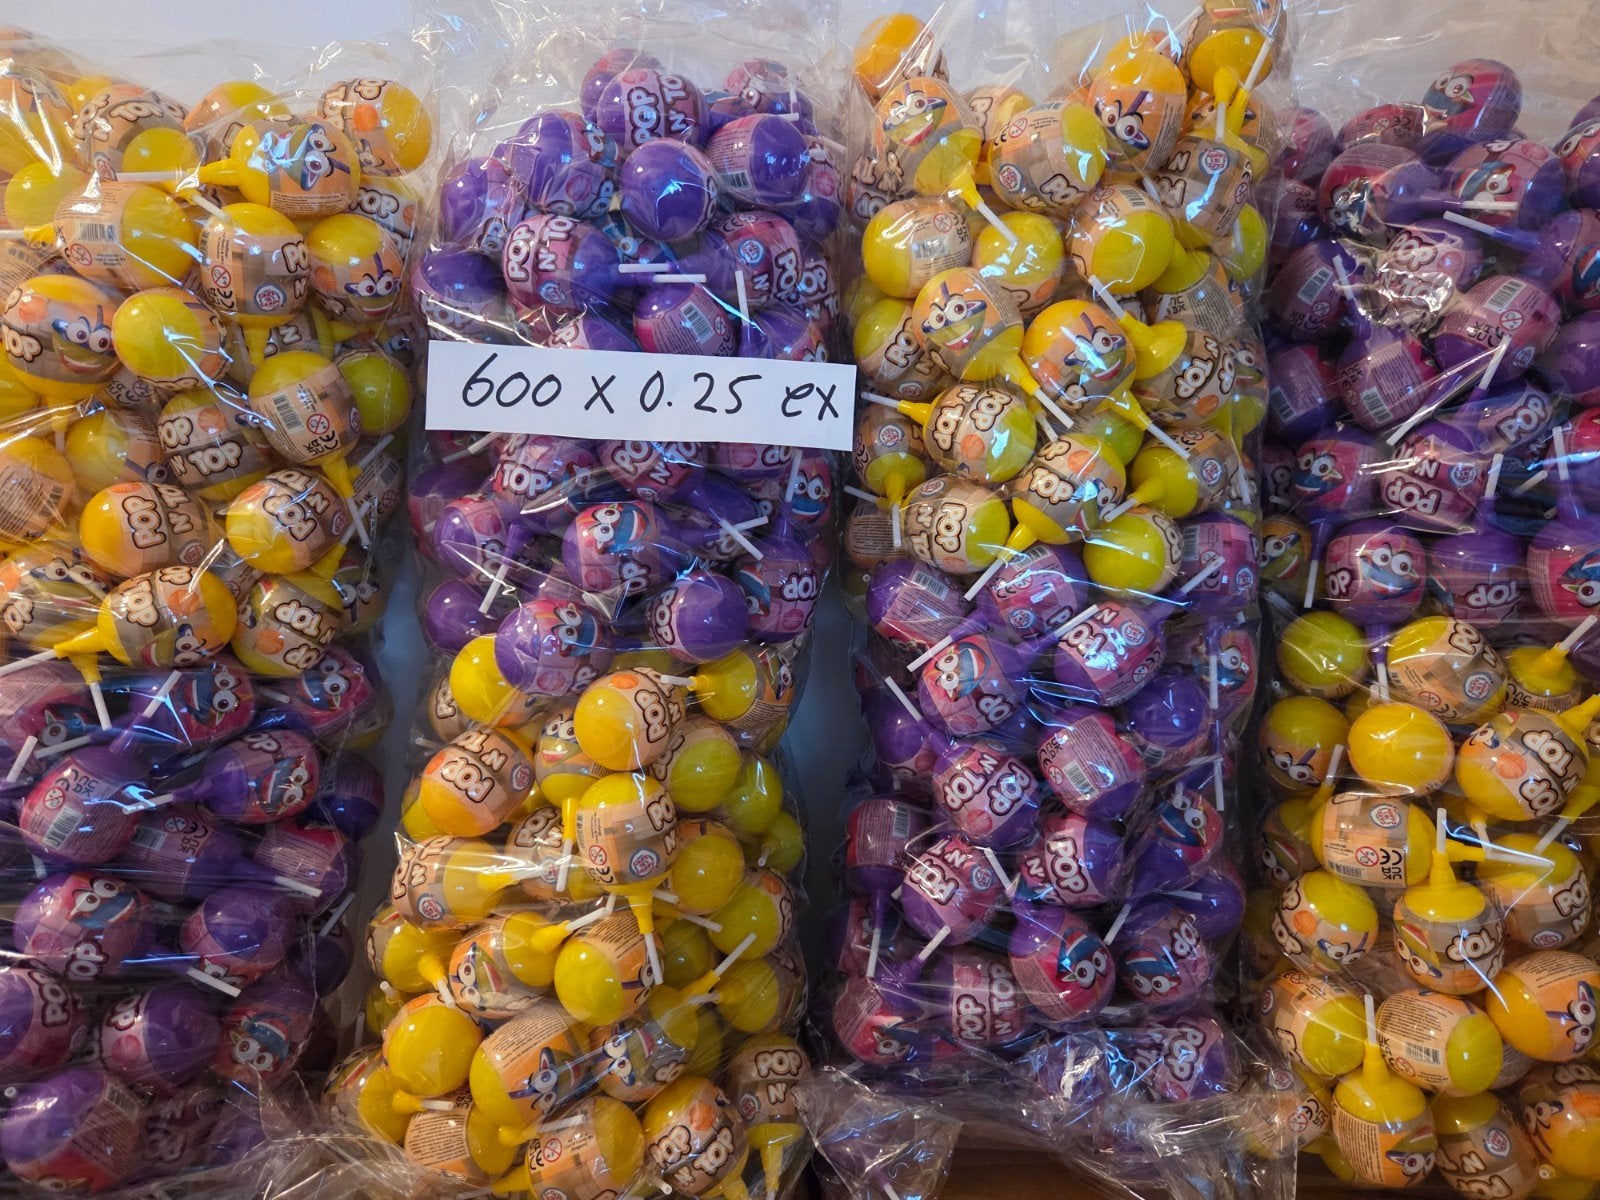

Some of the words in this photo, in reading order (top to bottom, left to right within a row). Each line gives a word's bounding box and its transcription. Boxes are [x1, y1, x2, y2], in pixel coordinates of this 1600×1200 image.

[659, 73, 689, 105] TO
[1039, 172, 1085, 206] PO
[540, 214, 578, 246] TO
[506, 224, 535, 282] POP
[798, 264, 829, 306] OP
[461, 352, 563, 408] 600
[780, 382, 840, 421] ex
[1173, 356, 1215, 400] TOP
[158, 416, 194, 448] OP
[930, 402, 965, 452] TOP
[1495, 394, 1550, 446] POP
[186, 440, 243, 476] TOP
[611, 440, 652, 477] PO
[500, 459, 553, 500] TOP
[1028, 466, 1075, 505] TOP
[1386, 476, 1443, 516] POP
[122, 494, 167, 550] POP
[262, 493, 318, 542] POP
[934, 501, 968, 553] POP
[619, 558, 652, 594] OP
[780, 571, 818, 603] TOP
[1327, 567, 1353, 600] OP
[1465, 580, 1521, 609] TOP
[274, 599, 323, 638] TOP
[655, 587, 678, 646] POP
[283, 643, 321, 670] OP
[1449, 618, 1482, 656] PO
[634, 688, 669, 744] POP
[976, 693, 1015, 725] OP
[245, 731, 282, 754] OP
[1521, 729, 1574, 778] TOP
[441, 756, 495, 804] POP
[942, 768, 988, 813] TOP
[986, 761, 1033, 817] POP
[645, 793, 677, 833] PO
[1047, 836, 1089, 894] POP
[64, 938, 109, 982] OP
[1445, 927, 1497, 962] TOP
[653, 1060, 687, 1084] OP
[754, 1049, 803, 1079] POP
[691, 1126, 736, 1176] TOP
